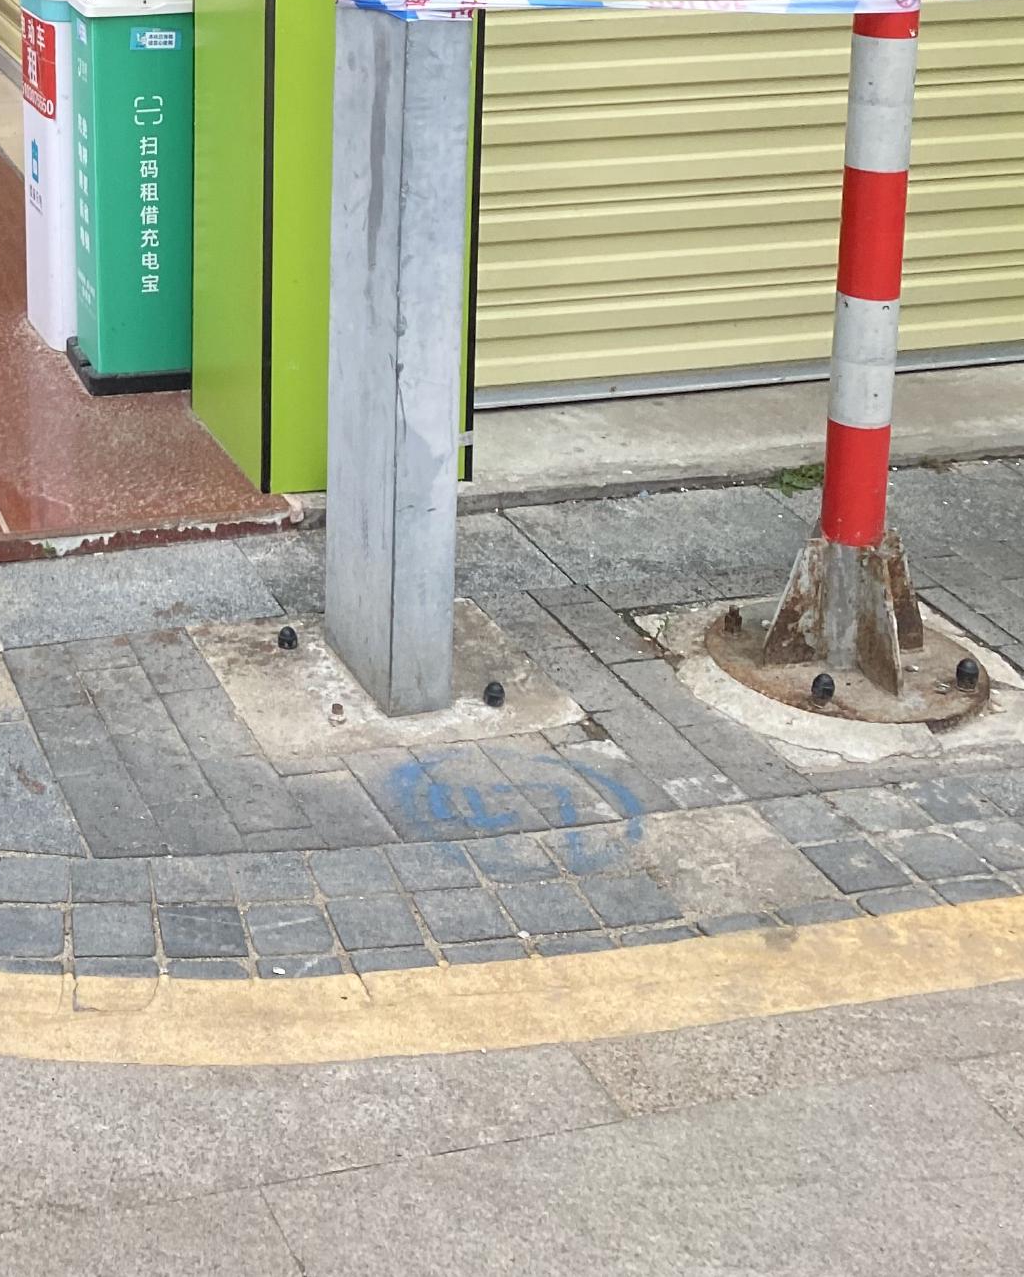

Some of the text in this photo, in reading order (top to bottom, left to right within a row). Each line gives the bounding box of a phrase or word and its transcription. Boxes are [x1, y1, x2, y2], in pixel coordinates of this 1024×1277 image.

[27, 46, 38, 89] 租
[139, 136, 160, 293] 扫码租借充电宝
